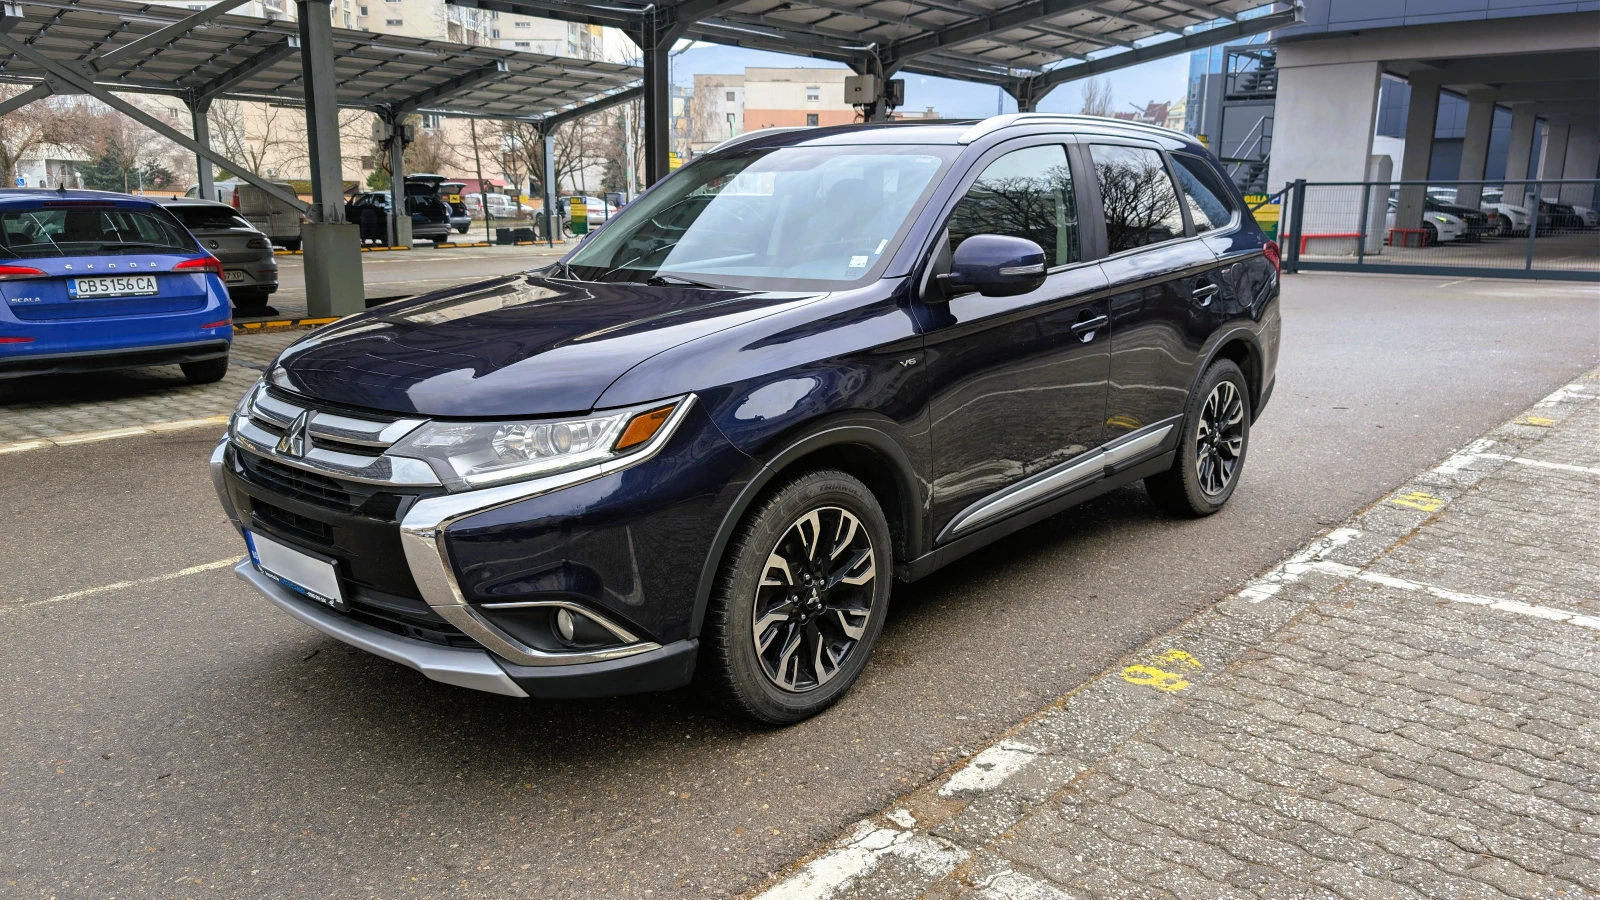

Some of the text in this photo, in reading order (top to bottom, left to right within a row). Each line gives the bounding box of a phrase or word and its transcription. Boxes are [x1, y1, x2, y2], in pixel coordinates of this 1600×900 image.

[232, 271, 242, 279] XP
[900, 358, 917, 367] V6
[818, 483, 865, 500] TRIANGLE
